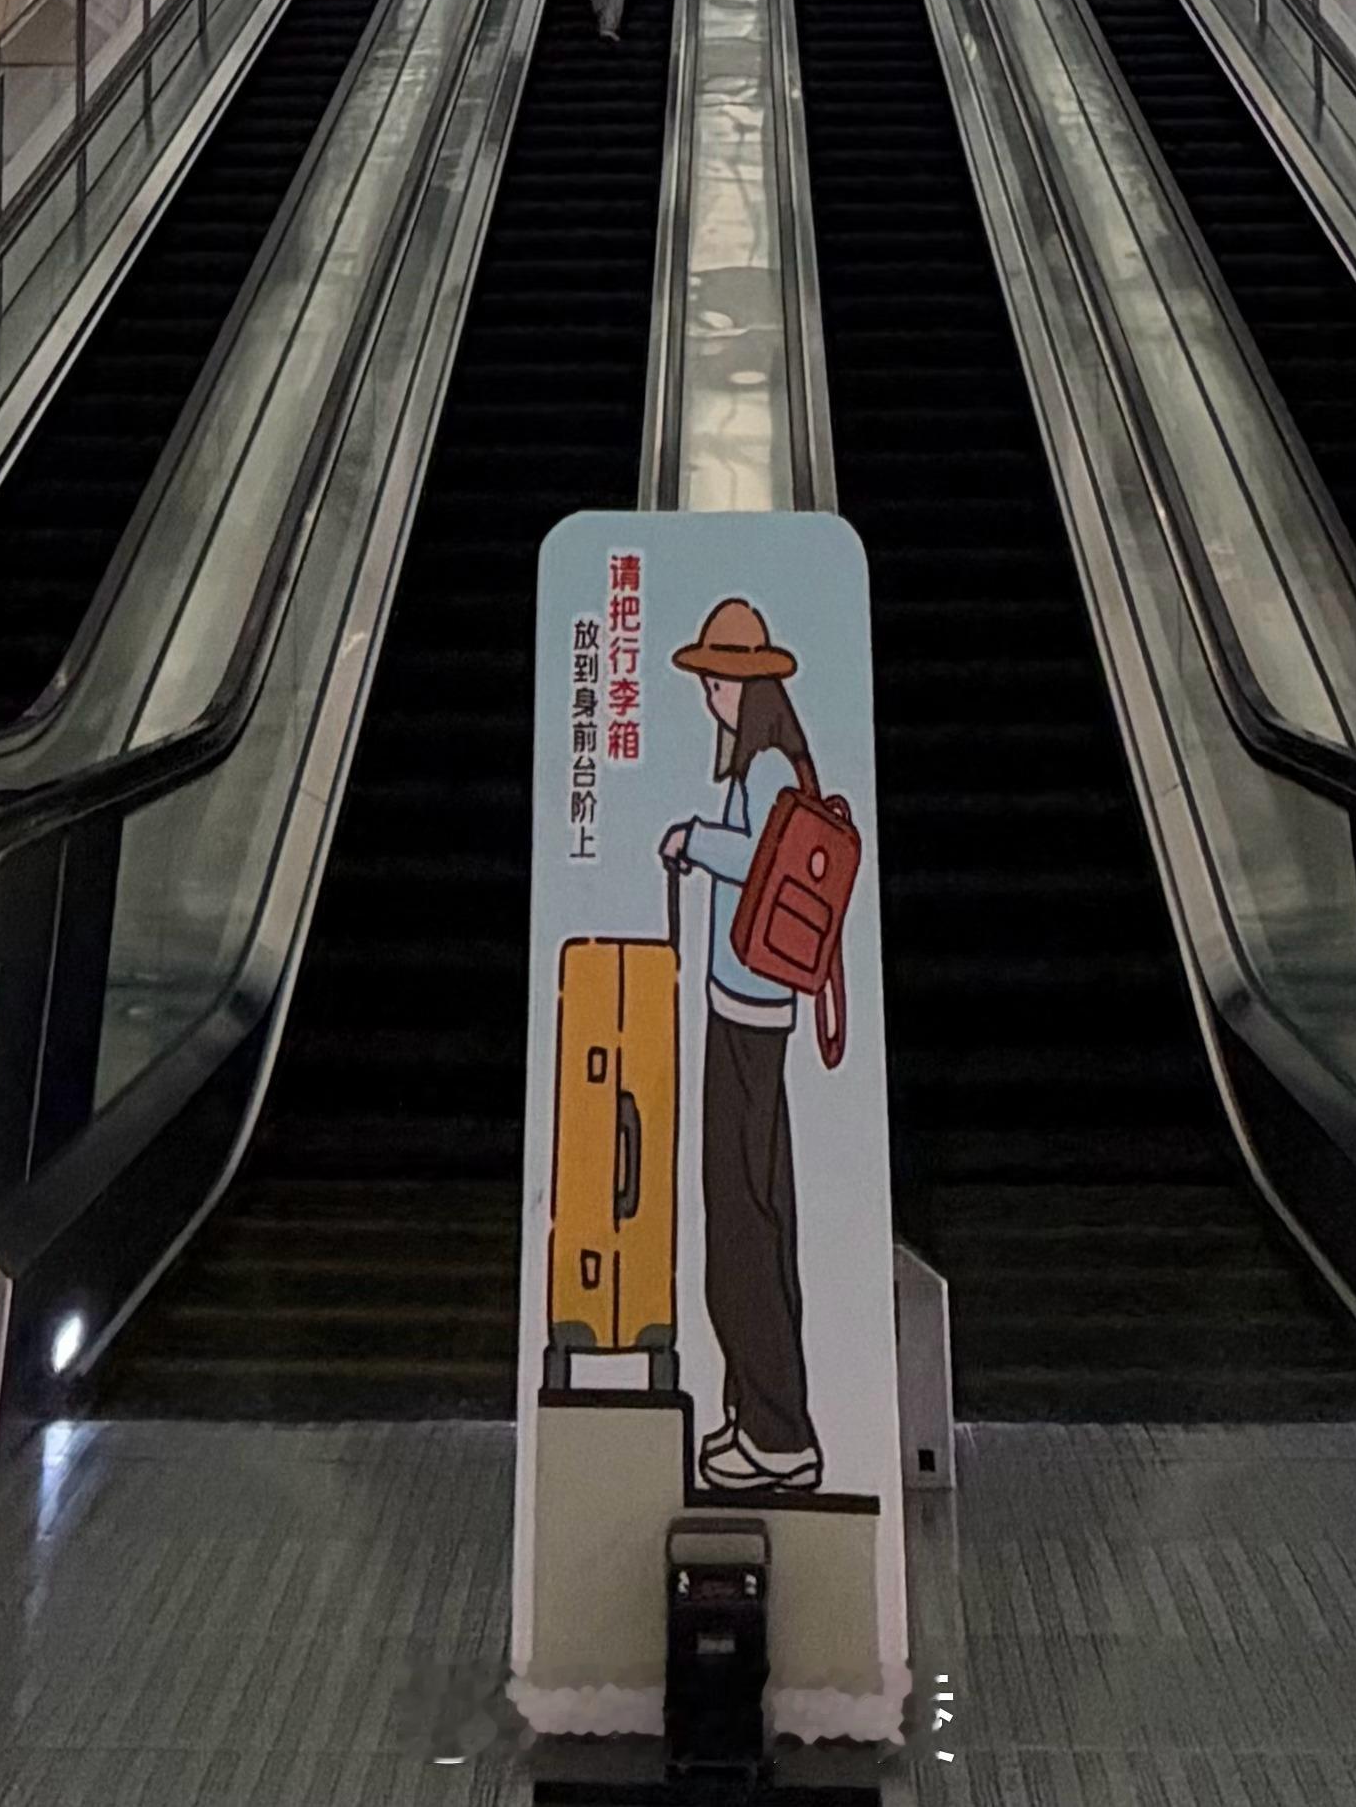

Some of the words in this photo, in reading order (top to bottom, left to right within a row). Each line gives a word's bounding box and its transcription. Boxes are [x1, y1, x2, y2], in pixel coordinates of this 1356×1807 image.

[569, 620, 600, 860] 放到身前台阶上
[607, 553, 642, 761] 请把行李箱
